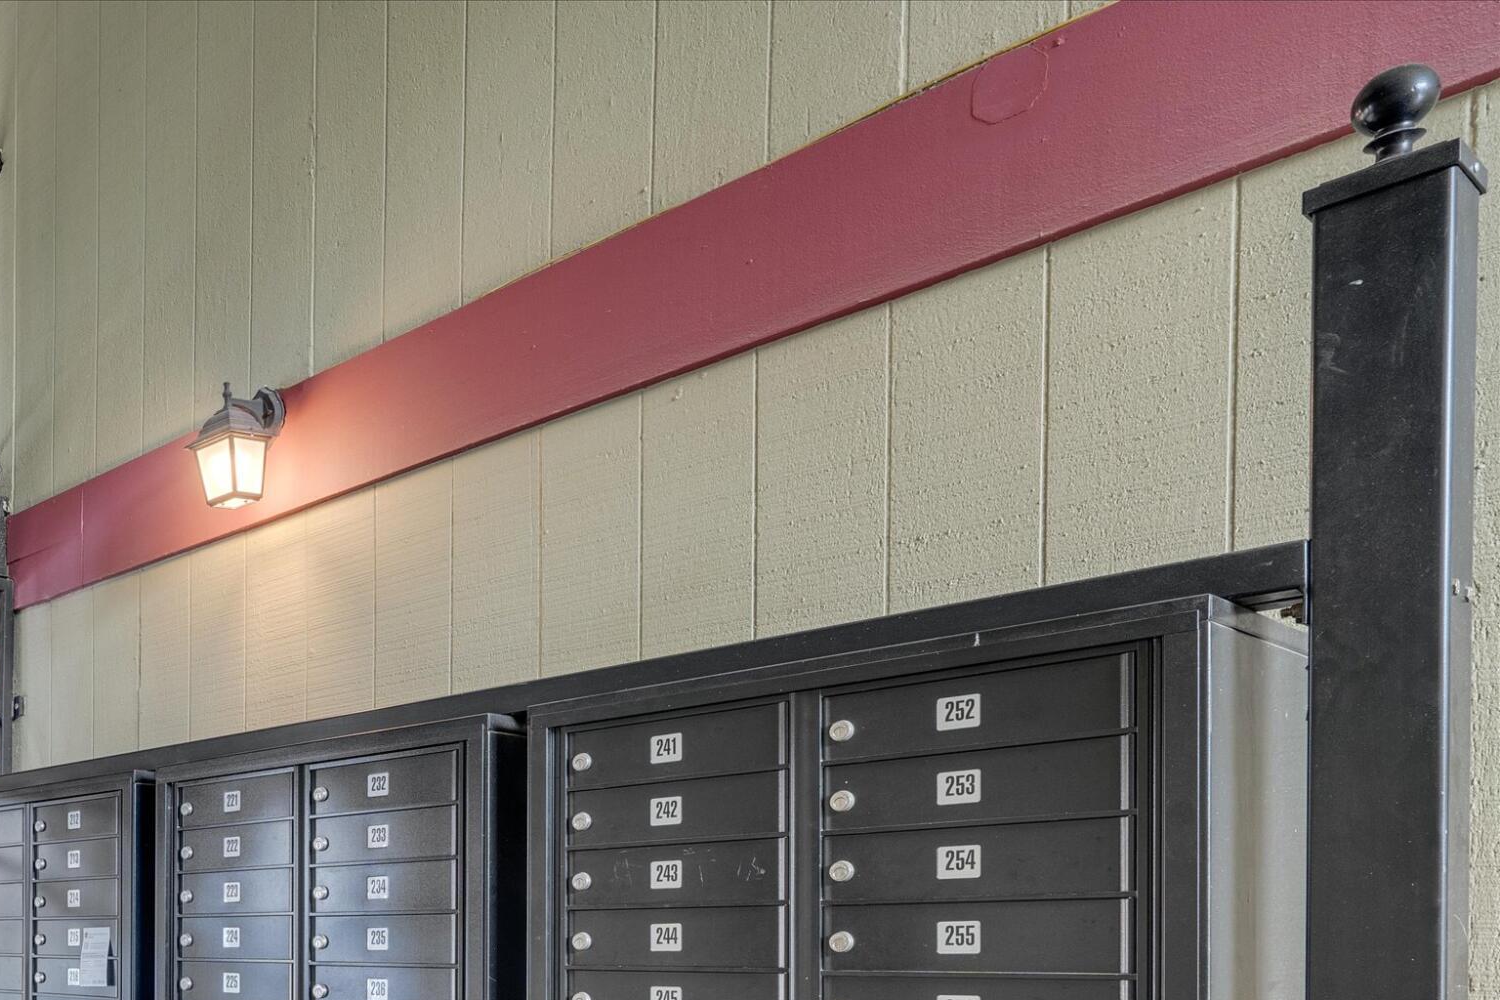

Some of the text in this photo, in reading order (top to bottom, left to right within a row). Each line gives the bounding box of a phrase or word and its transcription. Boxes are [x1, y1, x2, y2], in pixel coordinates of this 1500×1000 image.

[945, 698, 975, 722] 252
[656, 737, 676, 756] 241
[371, 776, 386, 791] 232
[945, 774, 975, 796] 253
[226, 793, 238, 807] 221
[656, 800, 677, 819] 242
[371, 827, 386, 843] 233
[226, 839, 238, 853] 222
[945, 849, 976, 871] 254
[656, 864, 678, 882] 243
[371, 879, 386, 894] 234
[226, 929, 238, 943] 224
[371, 930, 386, 945] 235
[656, 927, 678, 944] 244
[945, 925, 975, 946] 255
[370, 981, 386, 996] 236
